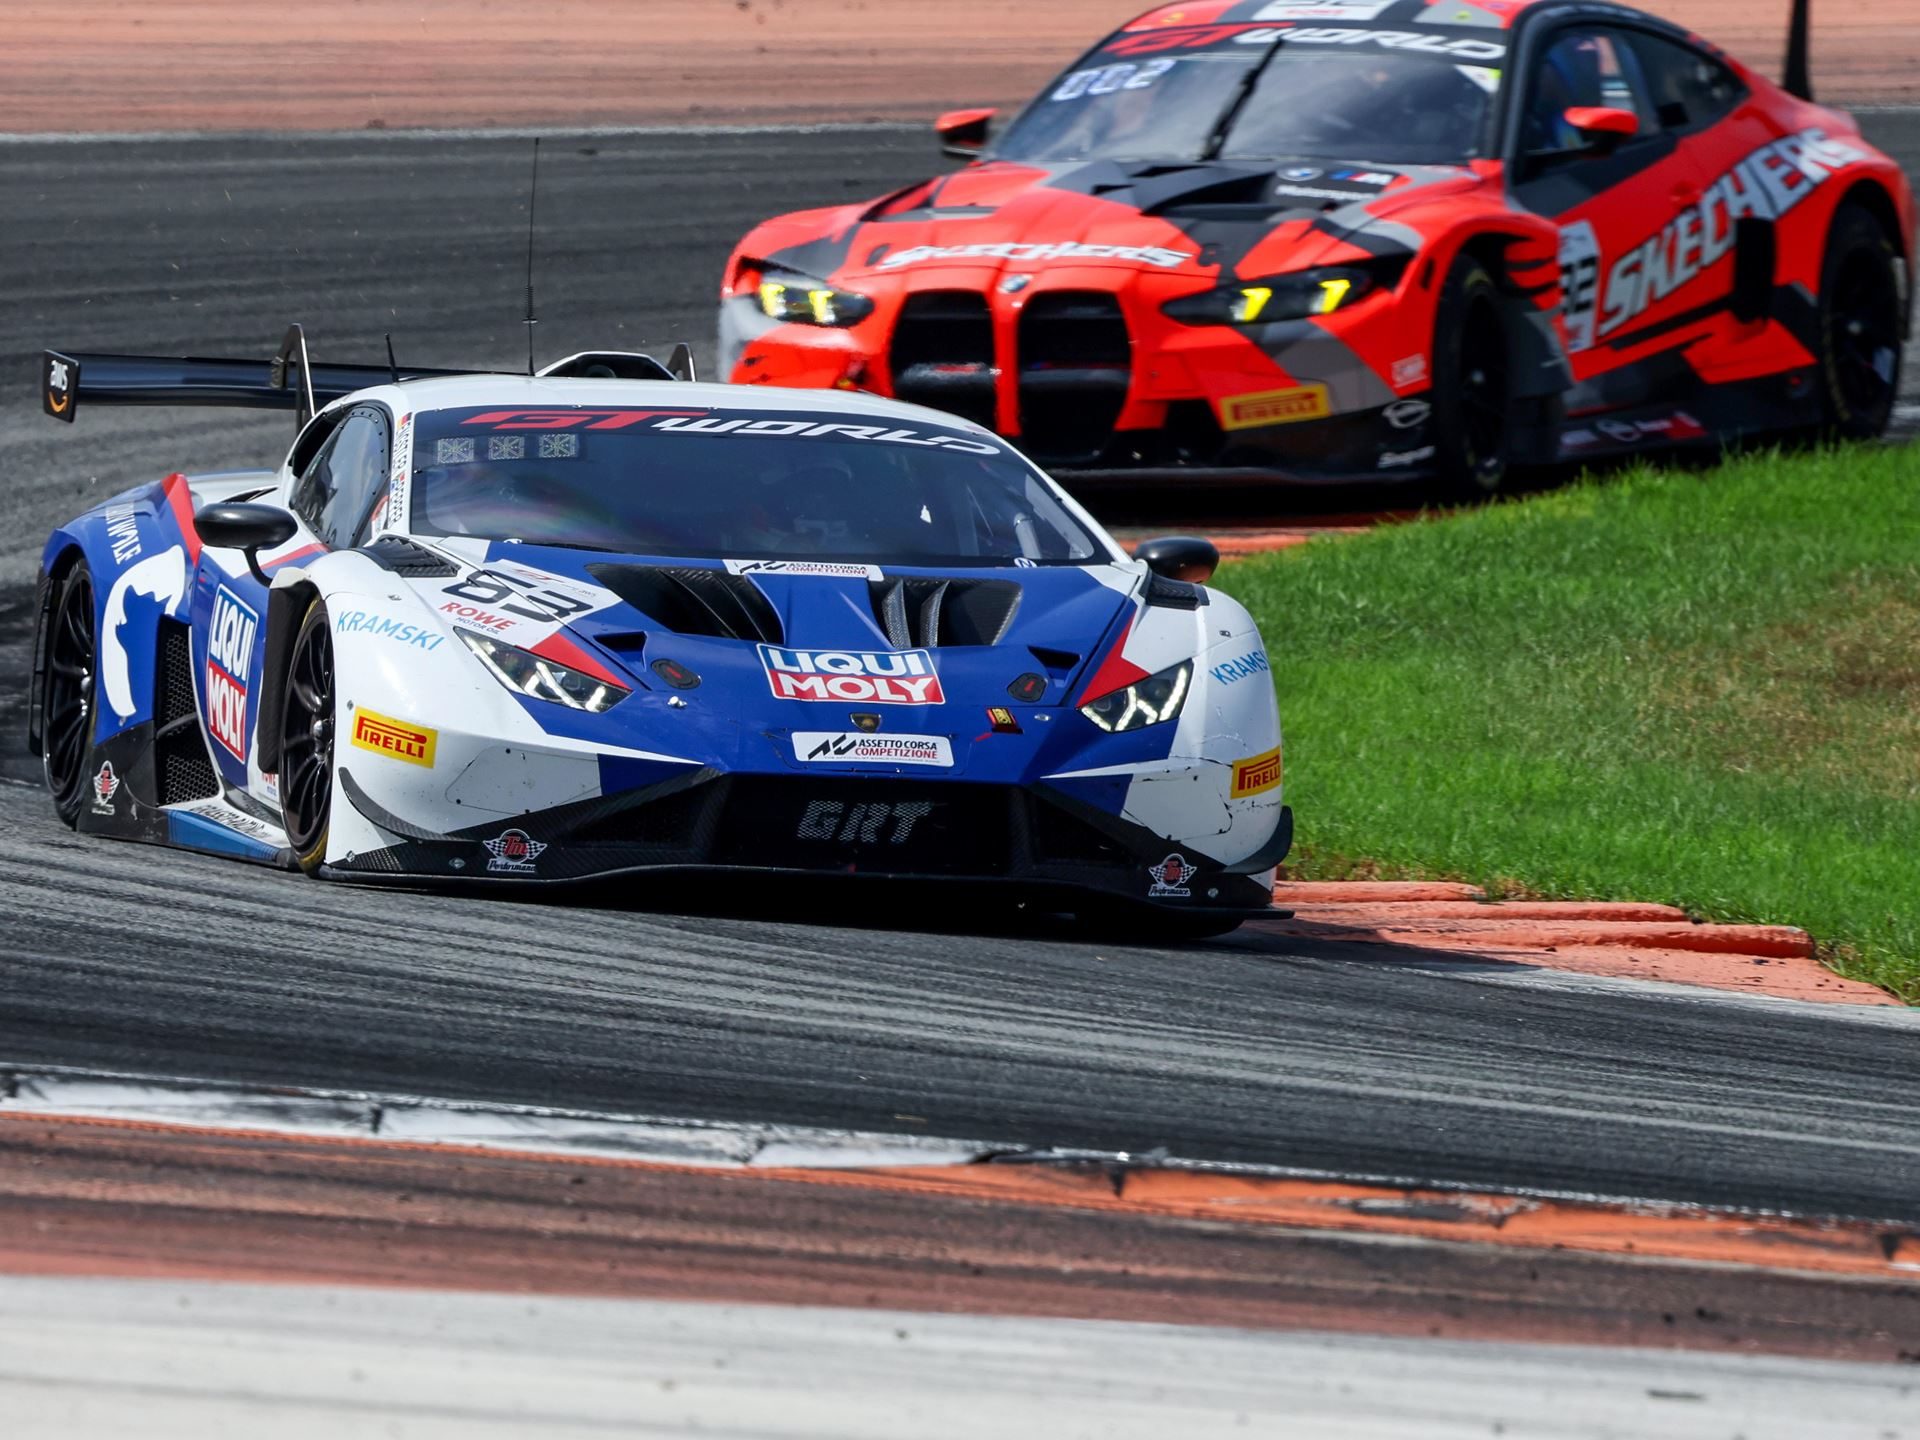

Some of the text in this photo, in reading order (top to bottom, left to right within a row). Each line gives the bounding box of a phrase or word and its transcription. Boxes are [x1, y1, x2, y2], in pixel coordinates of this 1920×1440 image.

[1234, 28, 1507, 59] WORLD
[1597, 127, 1870, 336] SKECHERS
[50, 360, 68, 391] aws
[460, 411, 1001, 455] GT WORLD
[785, 567, 868, 576] COMPETIZIONE
[788, 562, 833, 570] ASSETTO
[336, 610, 445, 651] KRAMSKI
[440, 602, 517, 631] ROWE
[455, 616, 487, 631] MOTOR
[210, 594, 254, 681] LIQUI
[767, 648, 927, 677] LIQUI
[777, 672, 934, 702] MOLY
[208, 667, 245, 752] MOLY
[356, 715, 427, 759] PIRELLI
[858, 739, 938, 750] ASSETTO CORSA
[855, 747, 938, 760] COMPETIZIONE
[797, 800, 934, 843] GRT
